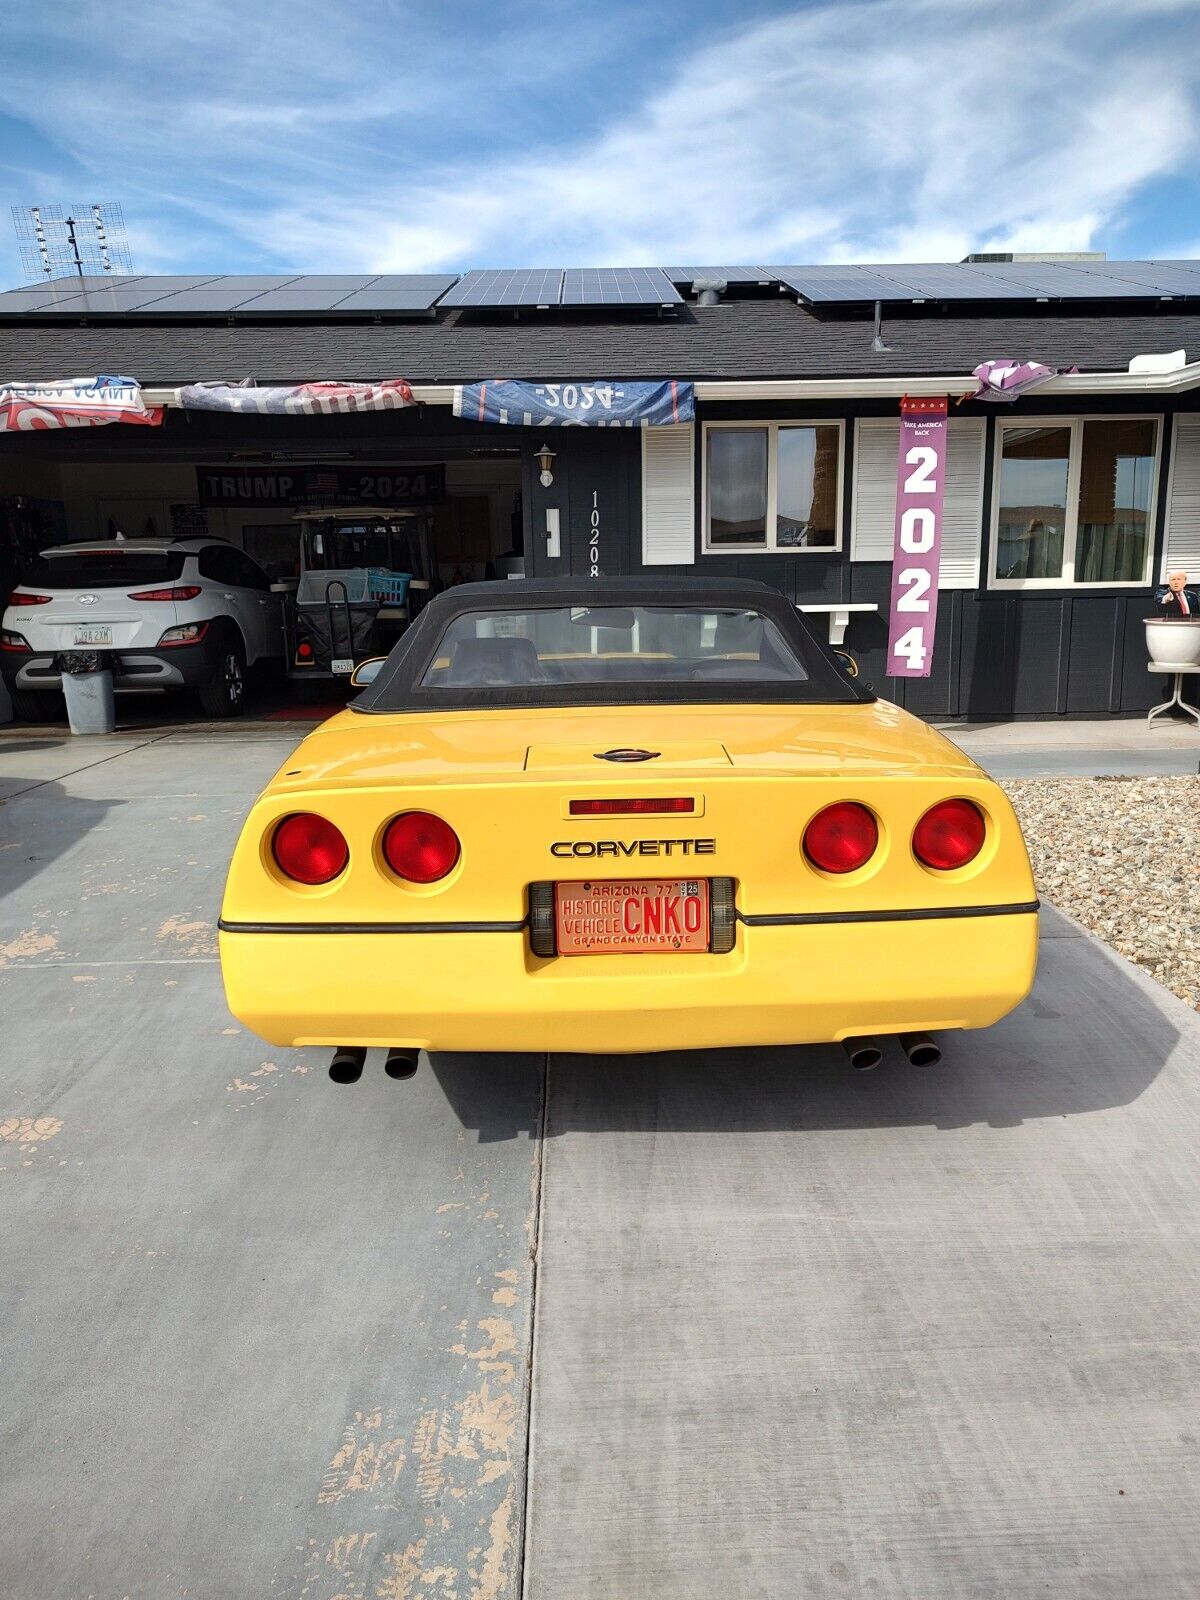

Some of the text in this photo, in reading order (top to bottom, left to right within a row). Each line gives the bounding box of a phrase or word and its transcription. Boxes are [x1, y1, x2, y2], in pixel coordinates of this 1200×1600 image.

[206, 475, 294, 498] TRUMP
[588, 490, 600, 577] 10208
[893, 446, 938, 671] 2024
[550, 838, 716, 858] CORVETTE
[592, 885, 672, 896] ARIZONA 77
[687, 884, 698, 893] 25
[562, 899, 620, 916] HISTORIC
[563, 918, 620, 935] VEHICLE
[573, 935, 692, 945] GRAND CANYON STATE
